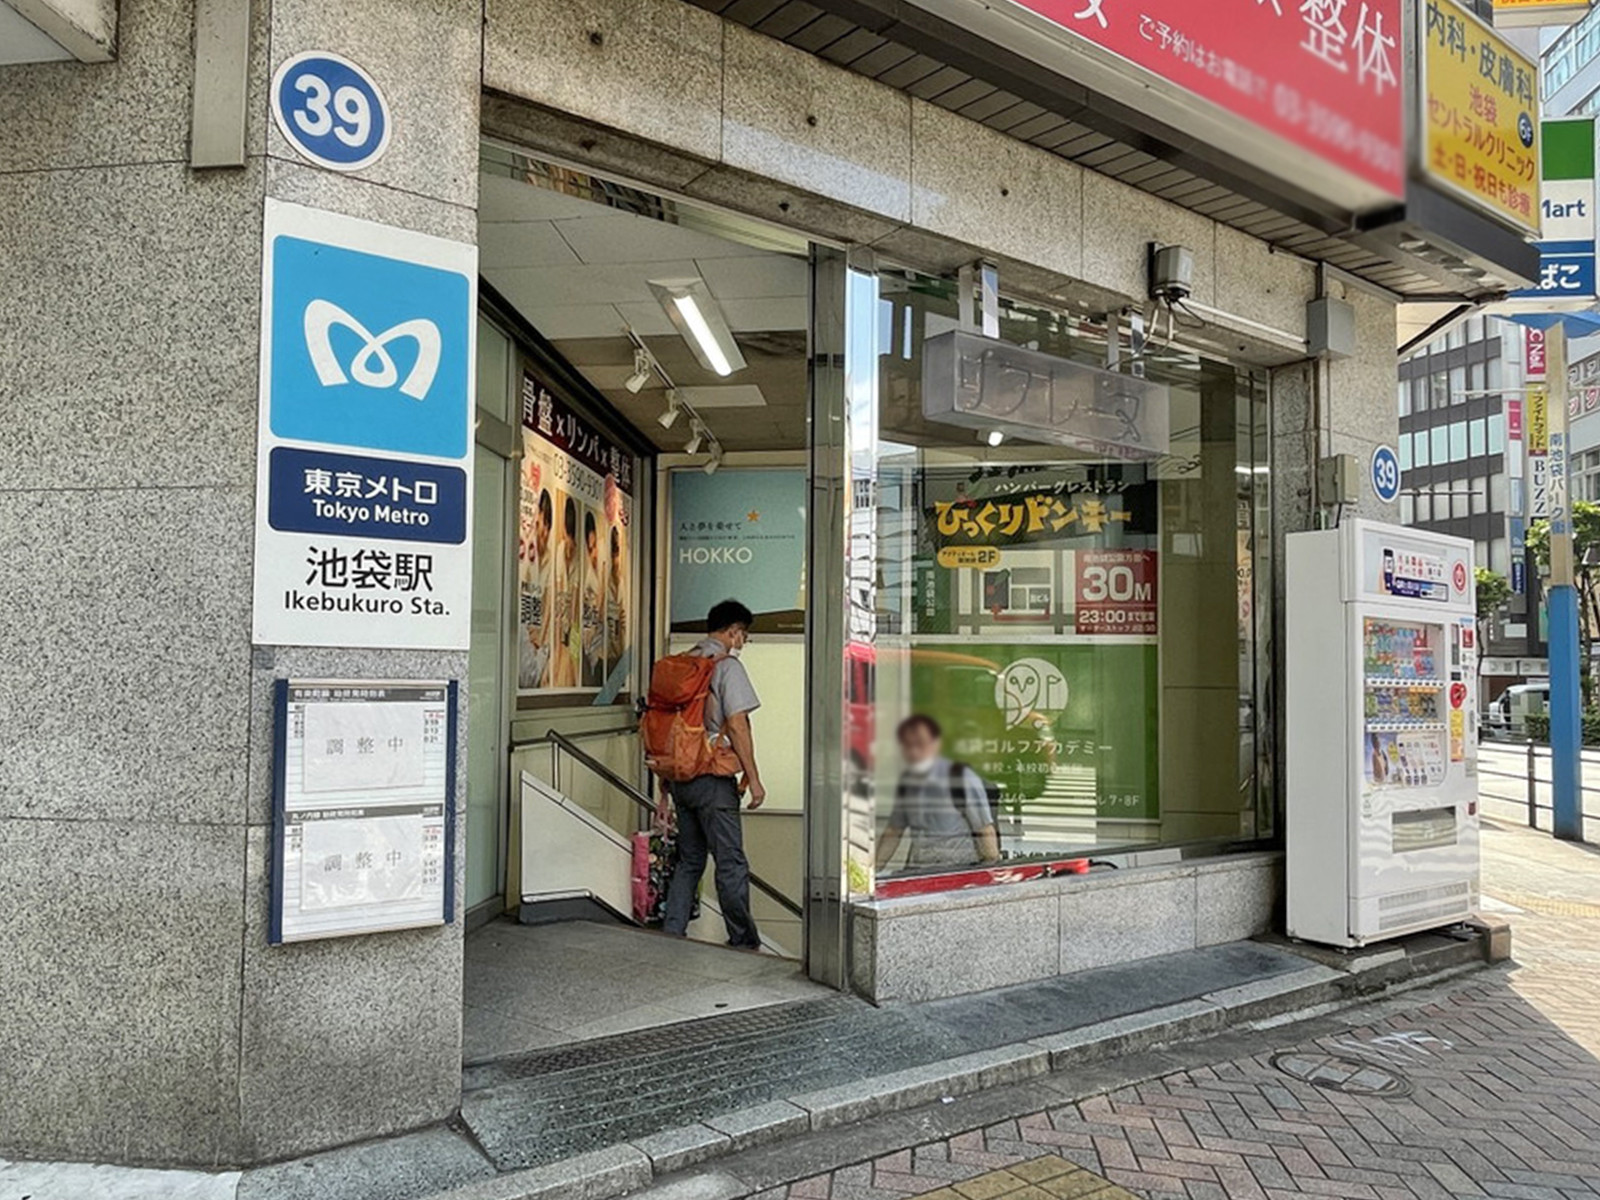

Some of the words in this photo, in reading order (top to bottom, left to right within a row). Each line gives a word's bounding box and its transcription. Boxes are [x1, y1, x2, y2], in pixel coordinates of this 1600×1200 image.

[1426, 1, 1533, 111] 内科・皮膚科
[293, 74, 371, 147] 39
[1428, 92, 1535, 181] セントラルクリニック
[1536, 263, 1581, 290] ばこ
[304, 468, 437, 504] 東京メトロ
[1376, 458, 1395, 490] 39
[1534, 460, 1547, 514] BUZZ
[312, 499, 370, 523] Tokyo
[374, 503, 430, 526] Metro
[305, 546, 433, 592] 池袋駅
[680, 546, 753, 564] HOKKO
[978, 550, 996, 563] 2F
[284, 590, 403, 615] Ikebukuro
[411, 597, 450, 616] Sta.
[1079, 610, 1126, 623] 23:00
[954, 739, 1113, 755] ゴルフアカデミー
